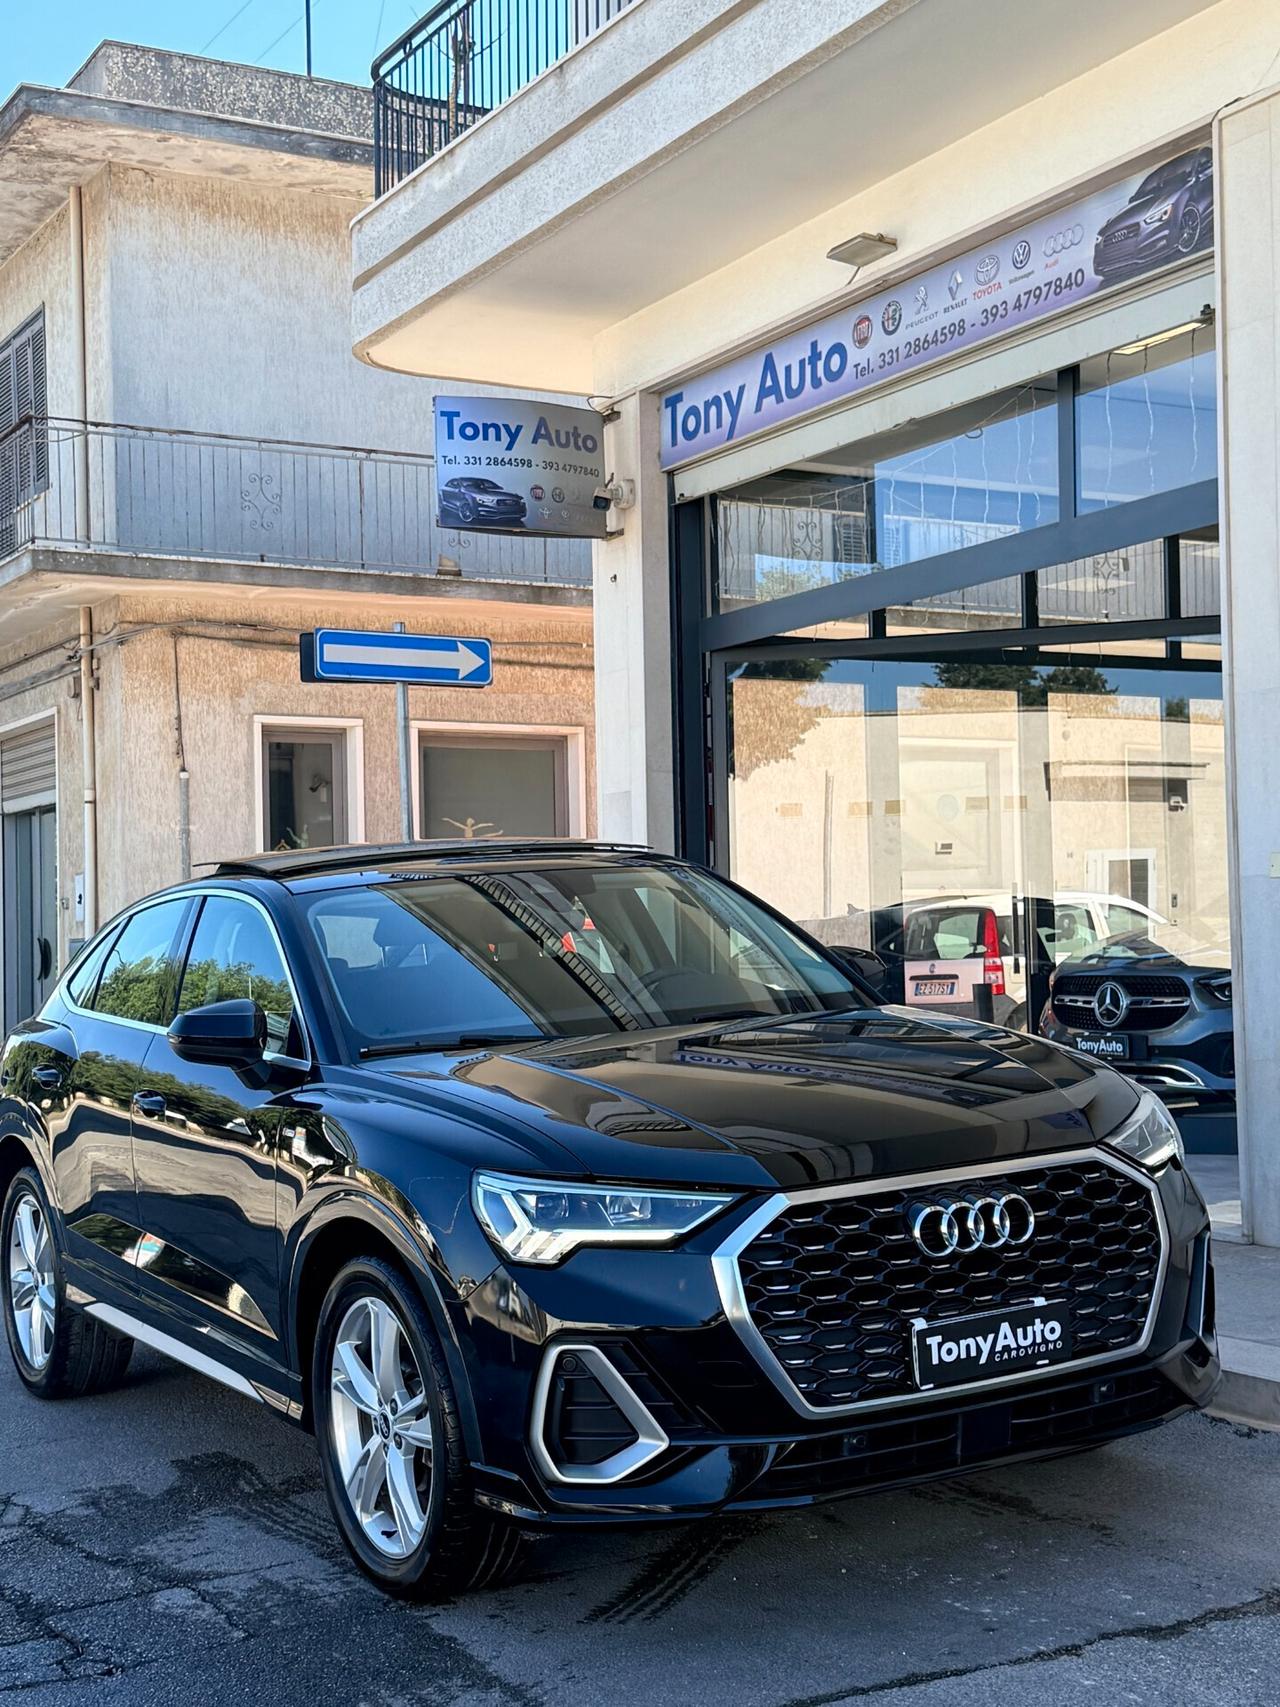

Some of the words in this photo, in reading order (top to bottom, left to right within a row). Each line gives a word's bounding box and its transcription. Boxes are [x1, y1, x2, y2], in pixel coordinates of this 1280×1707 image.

[972, 282, 1003, 300] TOYOTA
[853, 358, 874, 380] Tel.
[878, 346, 900, 369] 331
[904, 318, 966, 360] 2864598
[981, 300, 1008, 327] 393
[1012, 268, 1085, 312] 4797840
[905, 311, 939, 330] PEUGEOT
[664, 383, 746, 448] Tony
[754, 339, 848, 414] Auto
[440, 411, 523, 451] Tony
[531, 416, 598, 454] Auto
[442, 455, 461, 465] Tel.
[464, 456, 482, 466] 331
[486, 457, 532, 468] 2864598
[542, 460, 560, 472] 393
[562, 463, 600, 478] 4797840
[1076, 1037, 1123, 1054] TonyAuto
[926, 1318, 1062, 1365] TonyAuto
[995, 1341, 1063, 1362] CAROVIGNO
